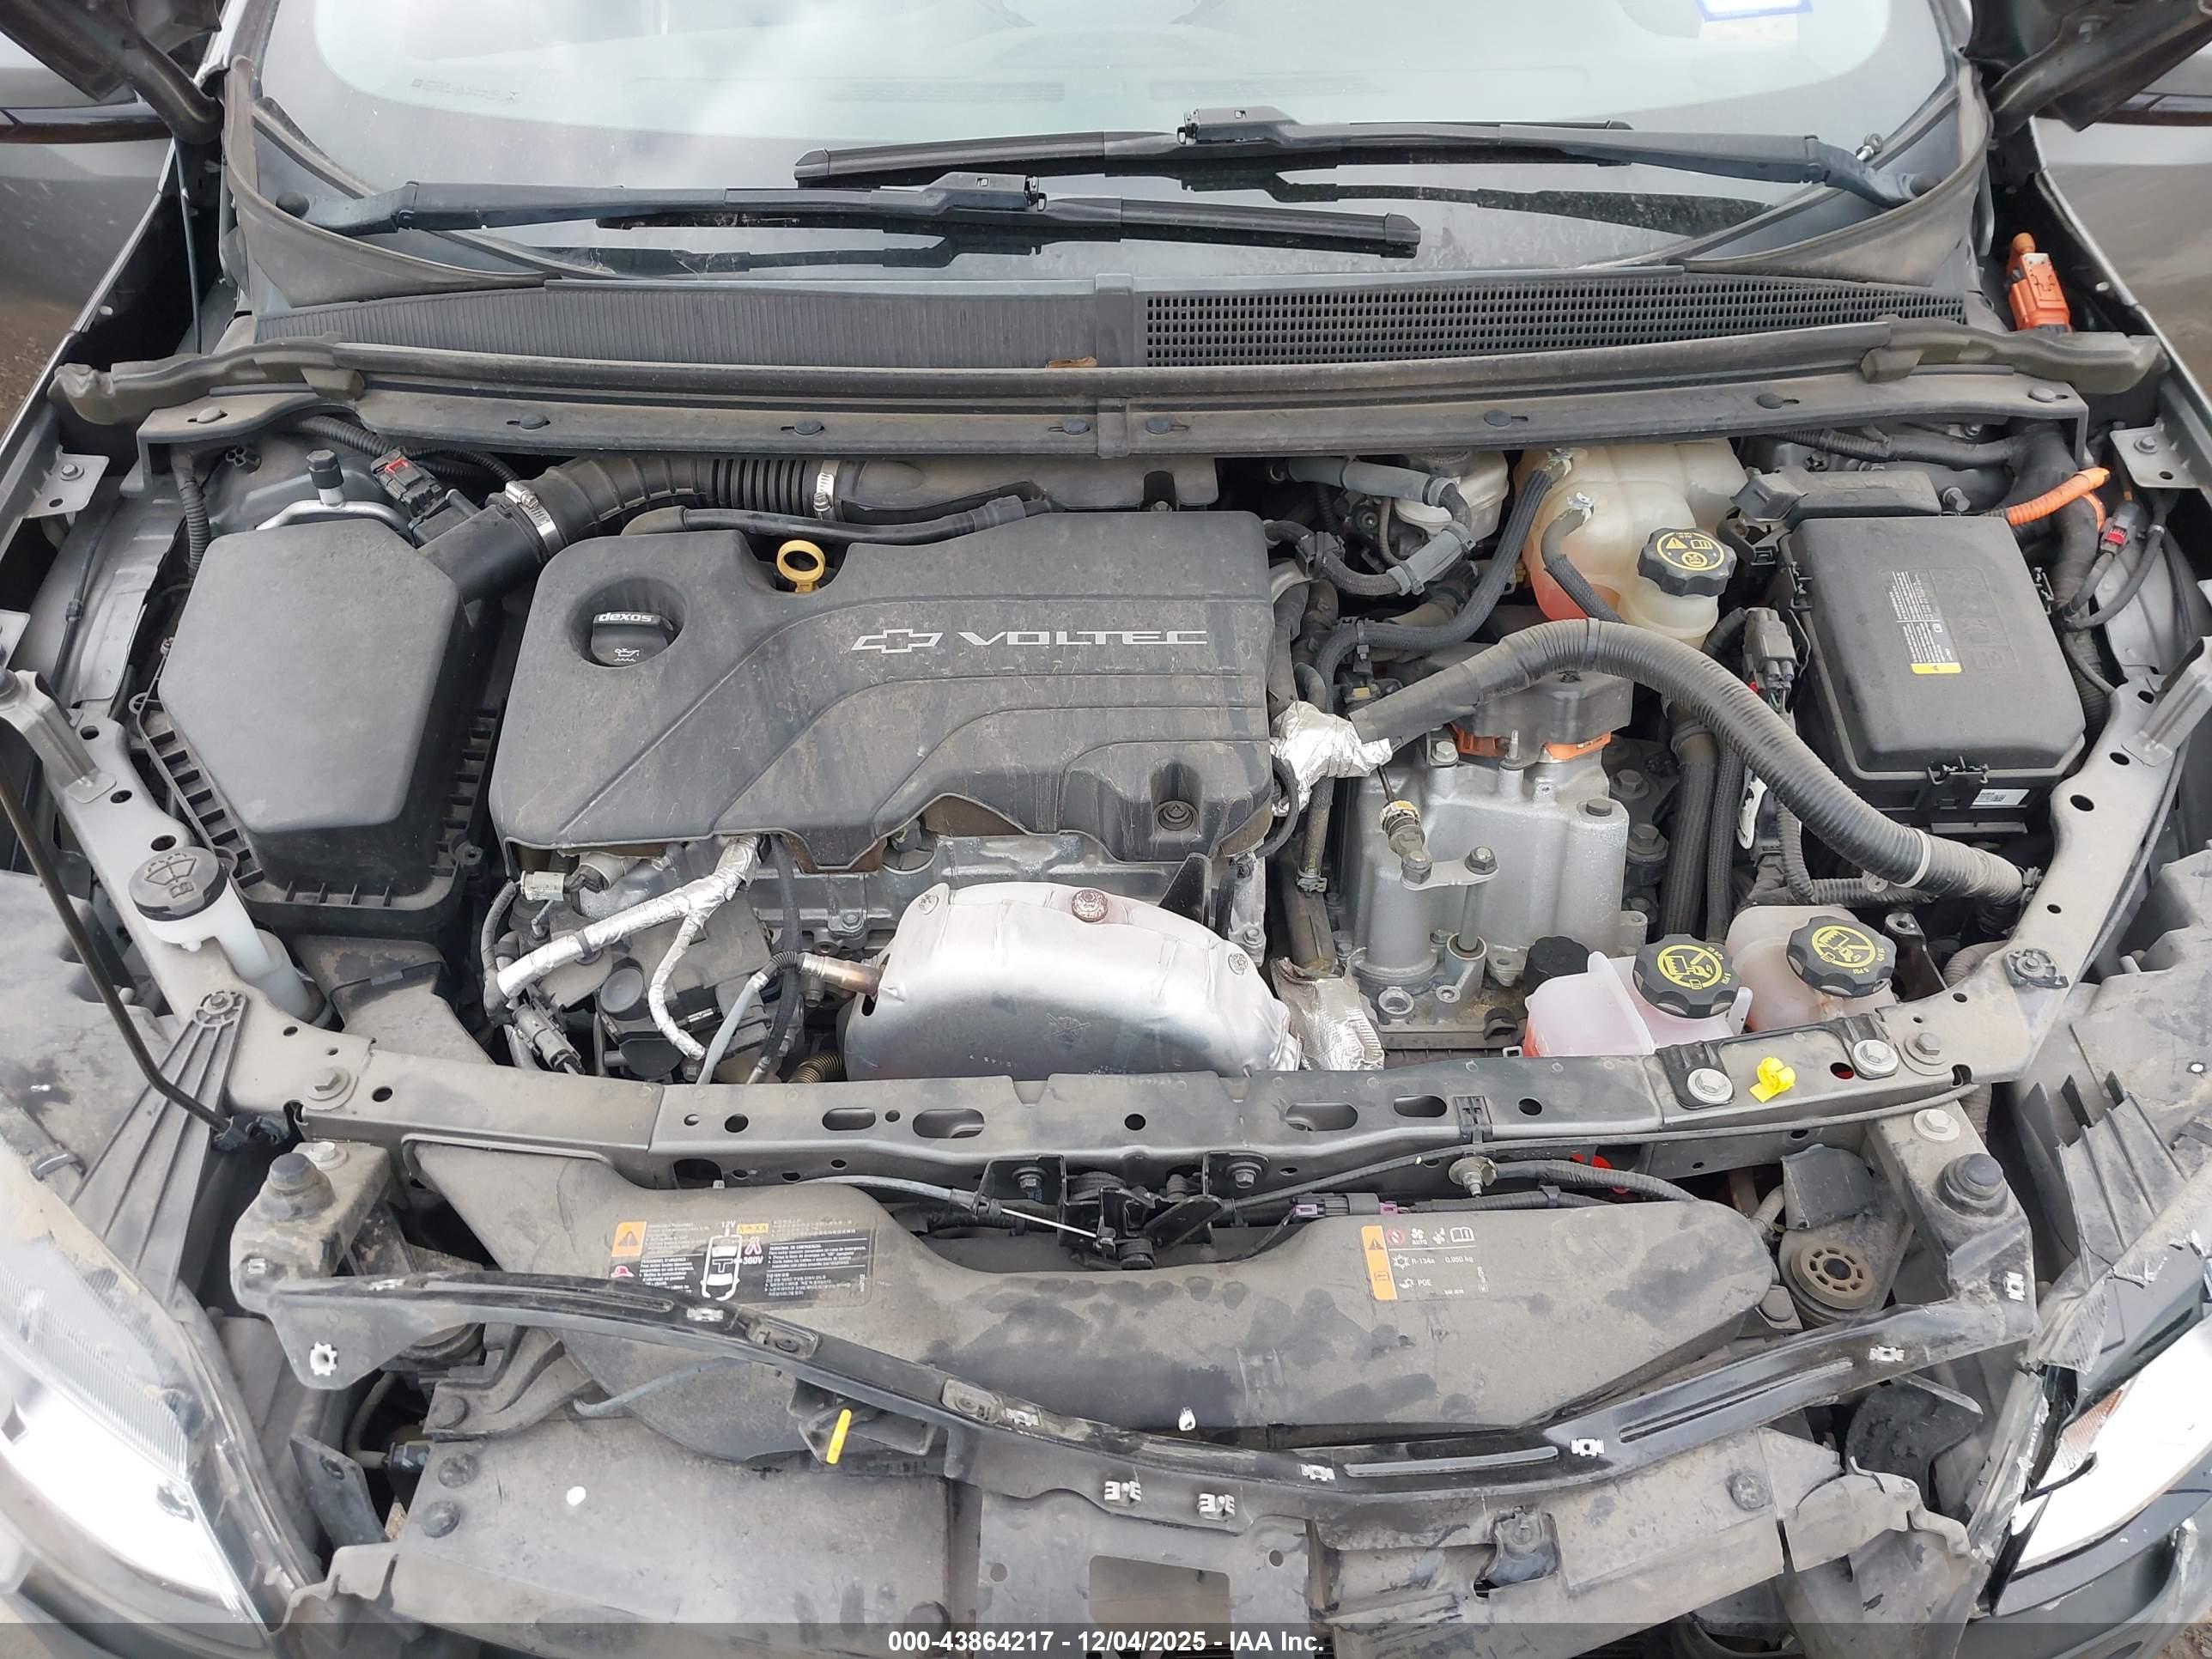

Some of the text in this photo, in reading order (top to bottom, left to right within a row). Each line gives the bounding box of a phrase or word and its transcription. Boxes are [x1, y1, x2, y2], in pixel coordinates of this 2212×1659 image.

[599, 612, 653, 622] dexos
[957, 631, 1207, 645] VOLTEC
[721, 1220, 736, 1229] 12V
